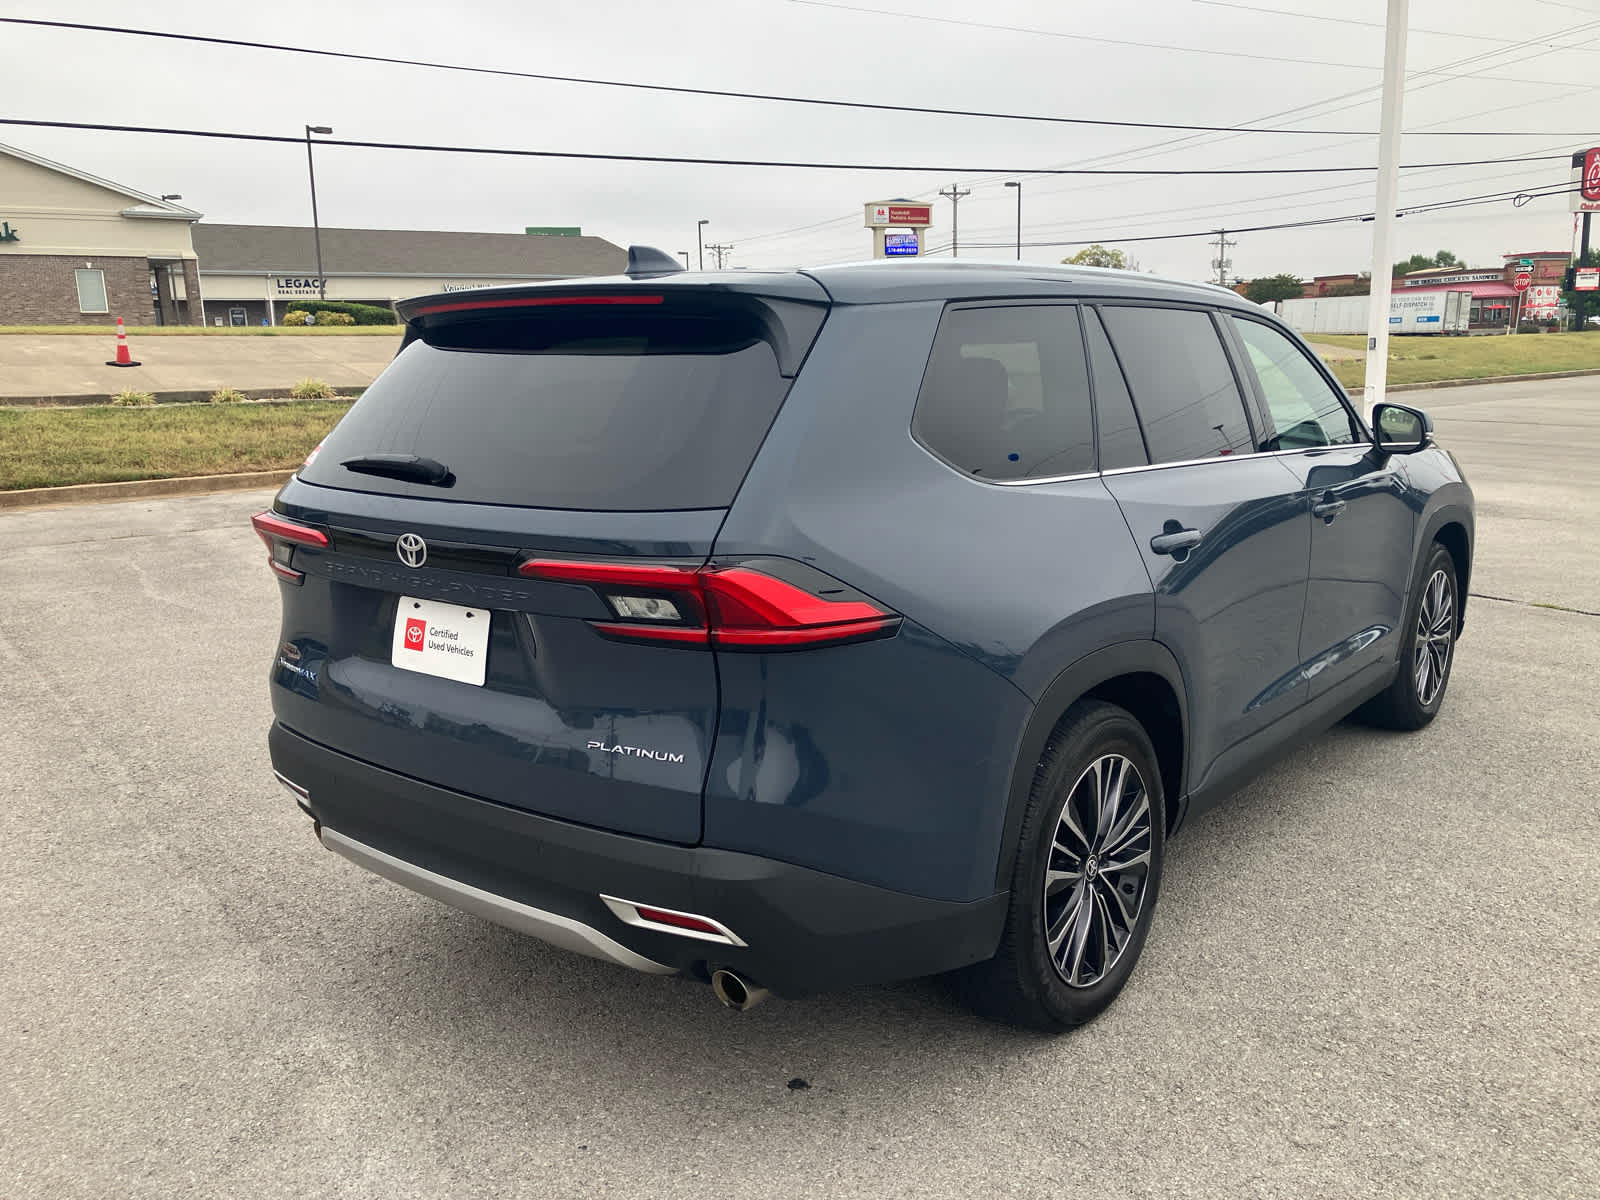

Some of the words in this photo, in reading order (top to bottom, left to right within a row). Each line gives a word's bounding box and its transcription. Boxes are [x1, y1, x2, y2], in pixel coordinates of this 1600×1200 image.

[277, 279, 327, 288] LEGACY
[1515, 278, 1530, 286] STOP
[429, 627, 458, 640] Certified
[428, 640, 445, 652] Used
[446, 643, 474, 657] Vehicles
[587, 741, 684, 763] PLATINUM
